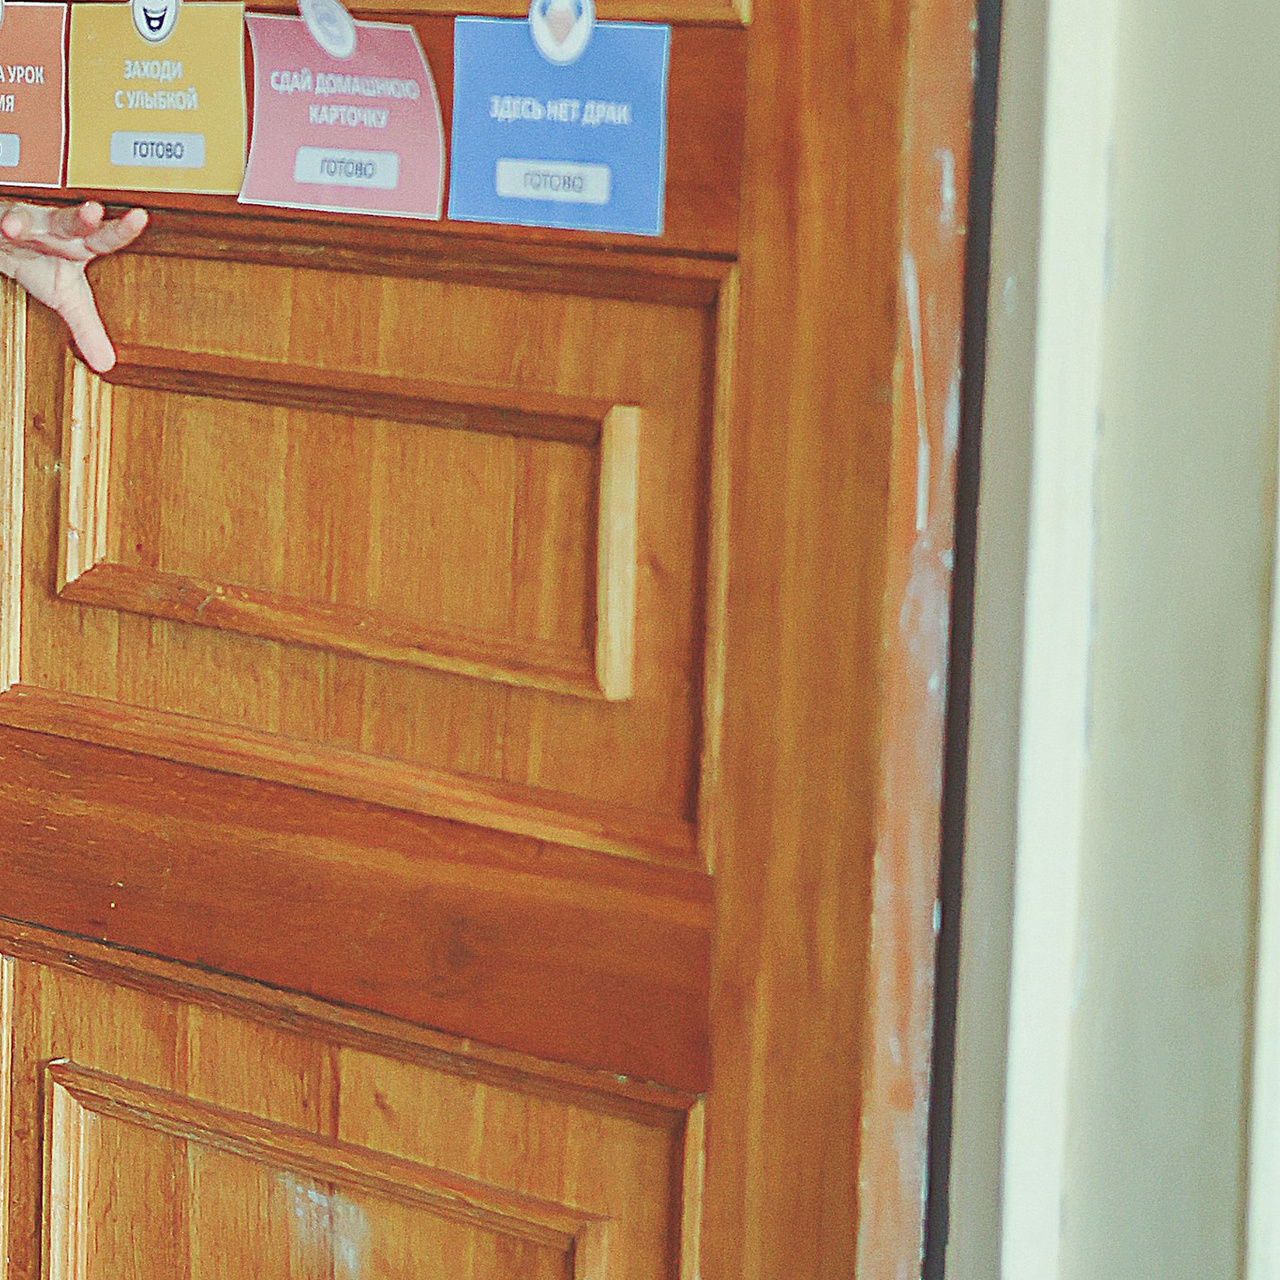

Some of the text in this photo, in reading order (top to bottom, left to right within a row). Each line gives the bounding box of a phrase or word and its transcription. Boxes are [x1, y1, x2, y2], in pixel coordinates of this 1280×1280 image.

[7, 65, 45, 84] УРОК
[124, 59, 184, 82] ЗАХОДИ
[270, 67, 420, 100] СДАЙ ДОМАШНЮЮ
[114, 86, 198, 110] С УЛЫБКОЙ
[309, 104, 390, 129] КАРТОЧКУ
[489, 95, 632, 126] ЗДЕСЬ НЕТ ДРАК
[133, 141, 184, 160] ГОТОВО
[320, 158, 377, 179] ГОТОВО
[523, 172, 585, 194] ГОТОВО
